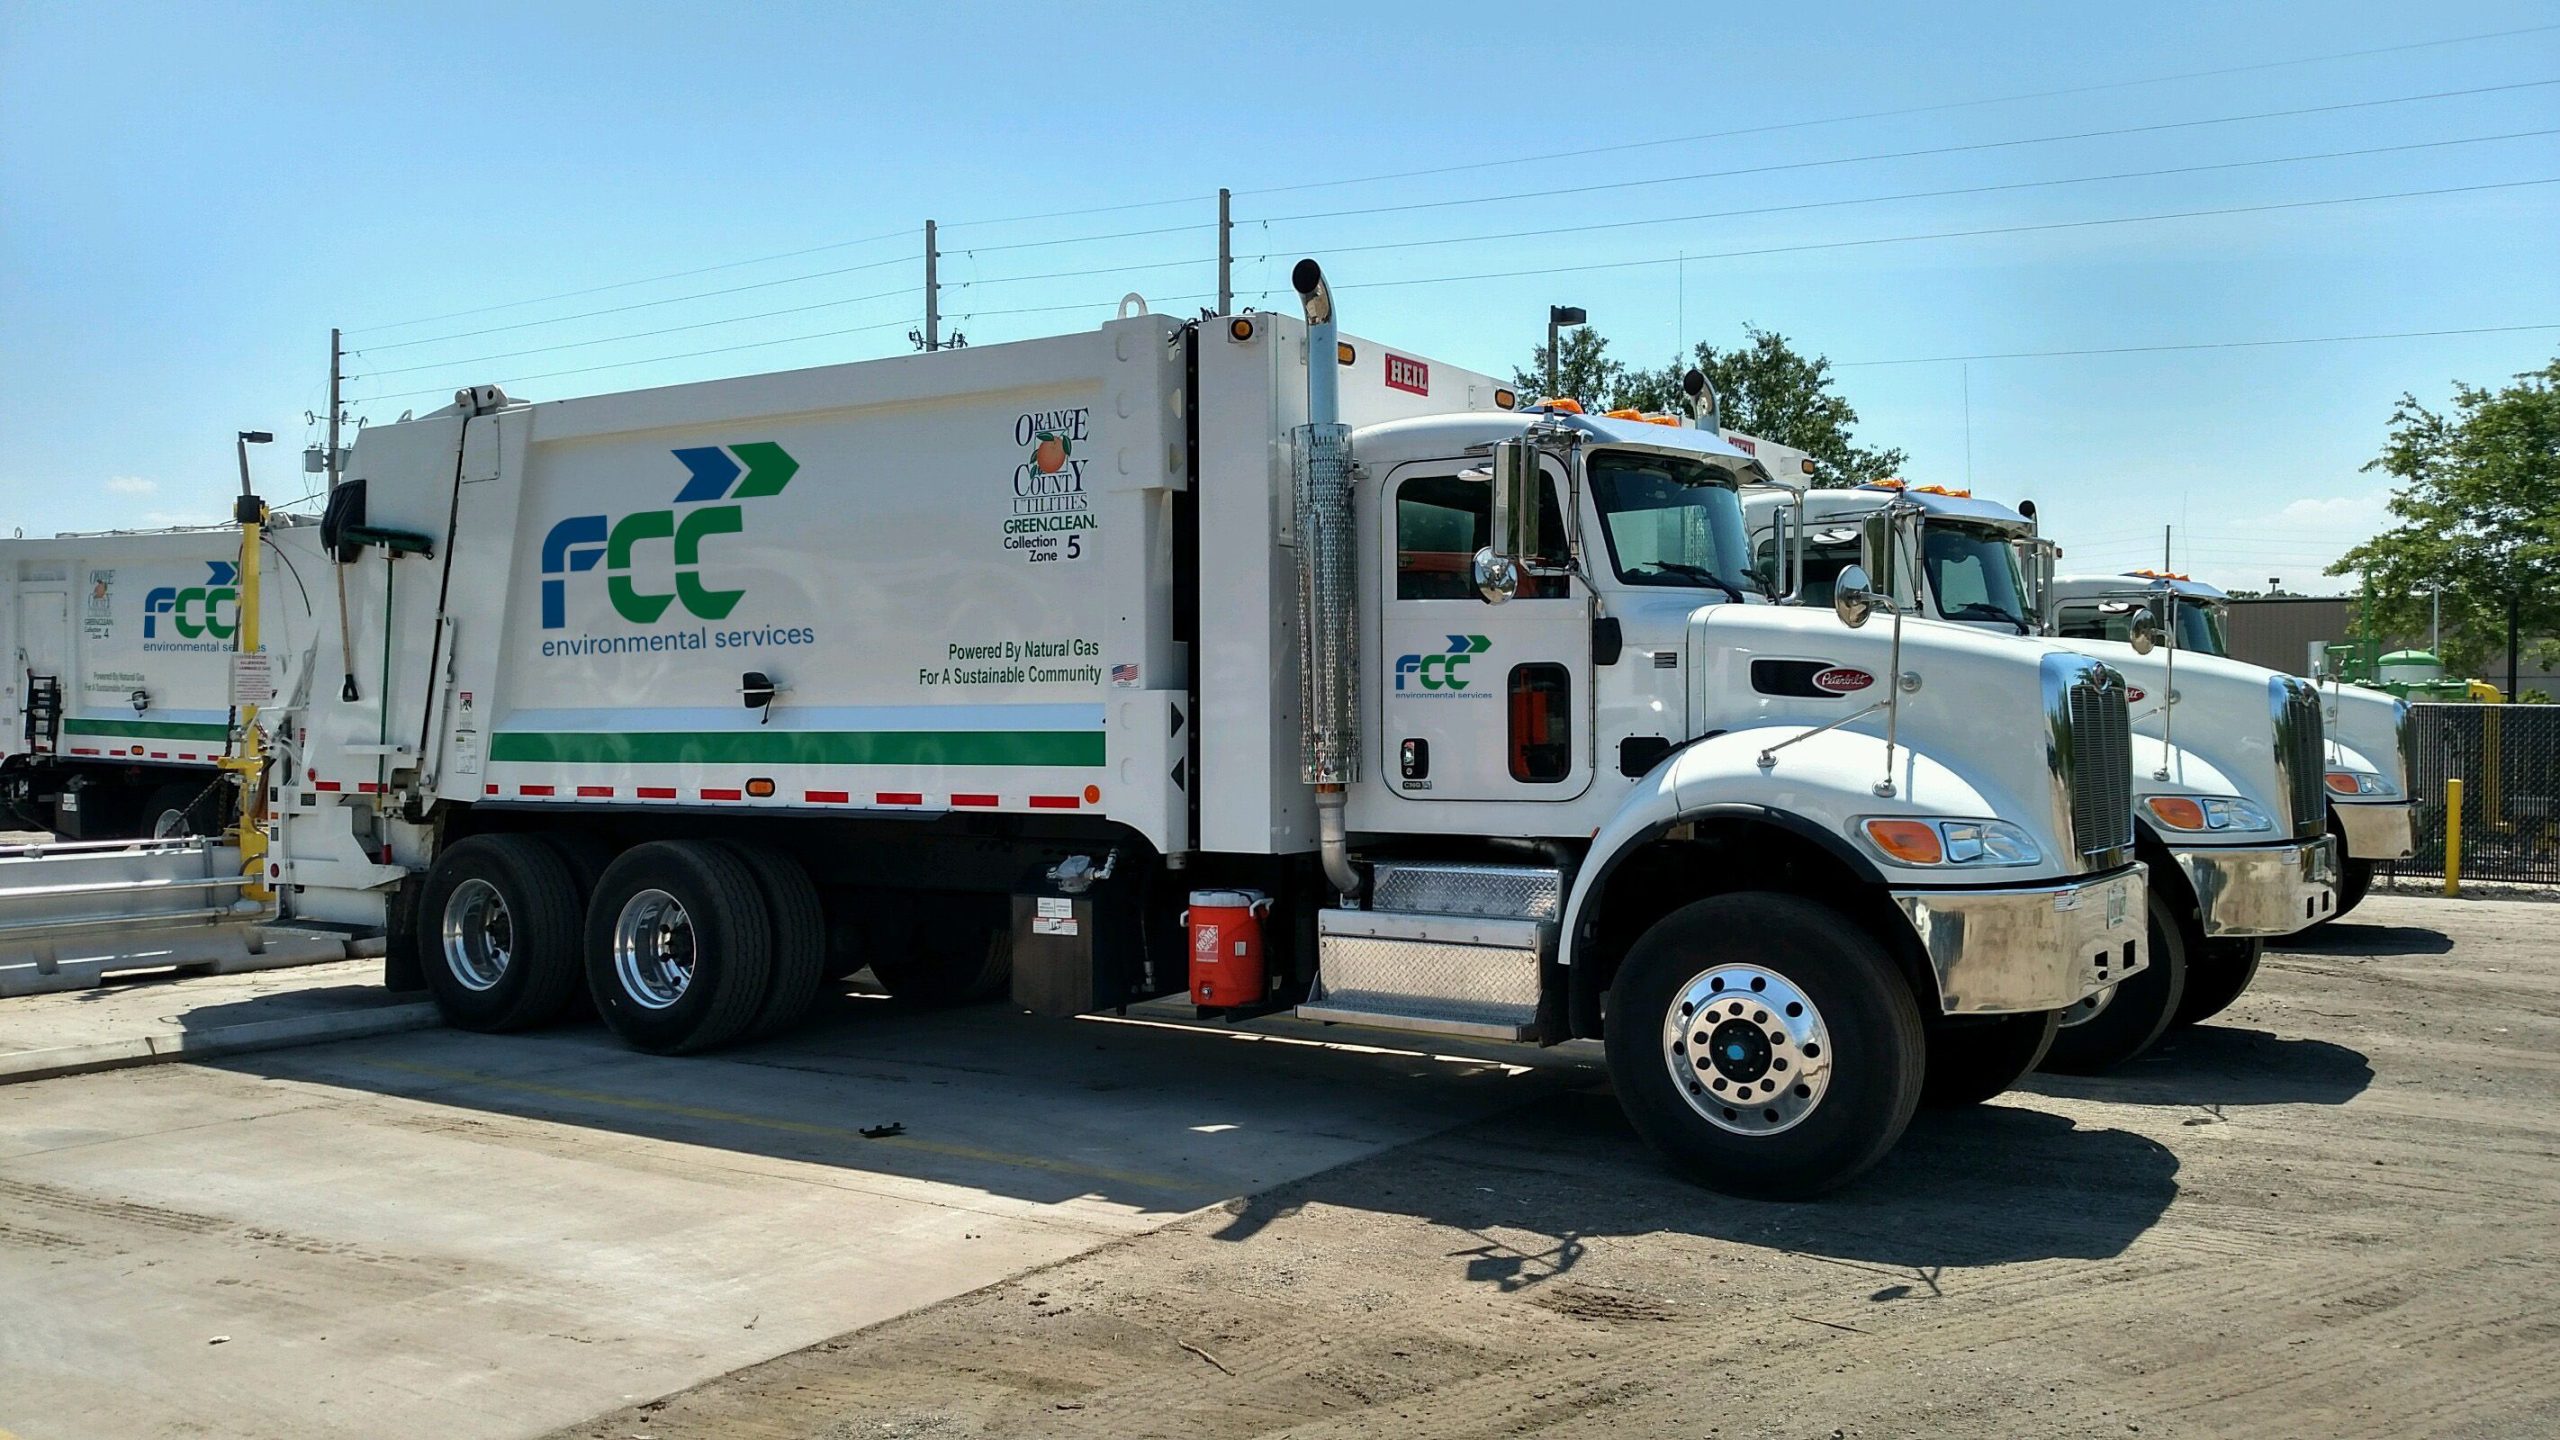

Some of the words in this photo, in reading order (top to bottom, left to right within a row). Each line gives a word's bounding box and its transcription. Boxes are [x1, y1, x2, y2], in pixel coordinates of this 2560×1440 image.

[1391, 360, 1428, 390] HEIL
[1015, 408, 1089, 447] ORANGE
[1014, 459, 1089, 497] COUNTY
[1013, 495, 1088, 513] UTILITIES
[1003, 514, 1099, 534] GREEN.CLEAN.
[1004, 535, 1058, 550] Collection
[1067, 535, 1081, 559] 5
[1029, 550, 1058, 562] Zone
[542, 504, 747, 629] FCC
[144, 587, 236, 639] FCC
[144, 641, 220, 652] environmental
[222, 643, 267, 652] sees
[542, 628, 707, 656] environmental
[715, 624, 815, 647] services
[949, 643, 1002, 660] Powered
[1005, 642, 1021, 662] By
[1024, 639, 1070, 658] Natural
[1073, 641, 1099, 656] Gas
[919, 668, 938, 684] For
[942, 668, 951, 683] A
[954, 667, 1025, 684] Sustainable
[1028, 665, 1102, 685] Community
[1395, 655, 1471, 690] FCC
[1821, 672, 1869, 686] Peterbilt
